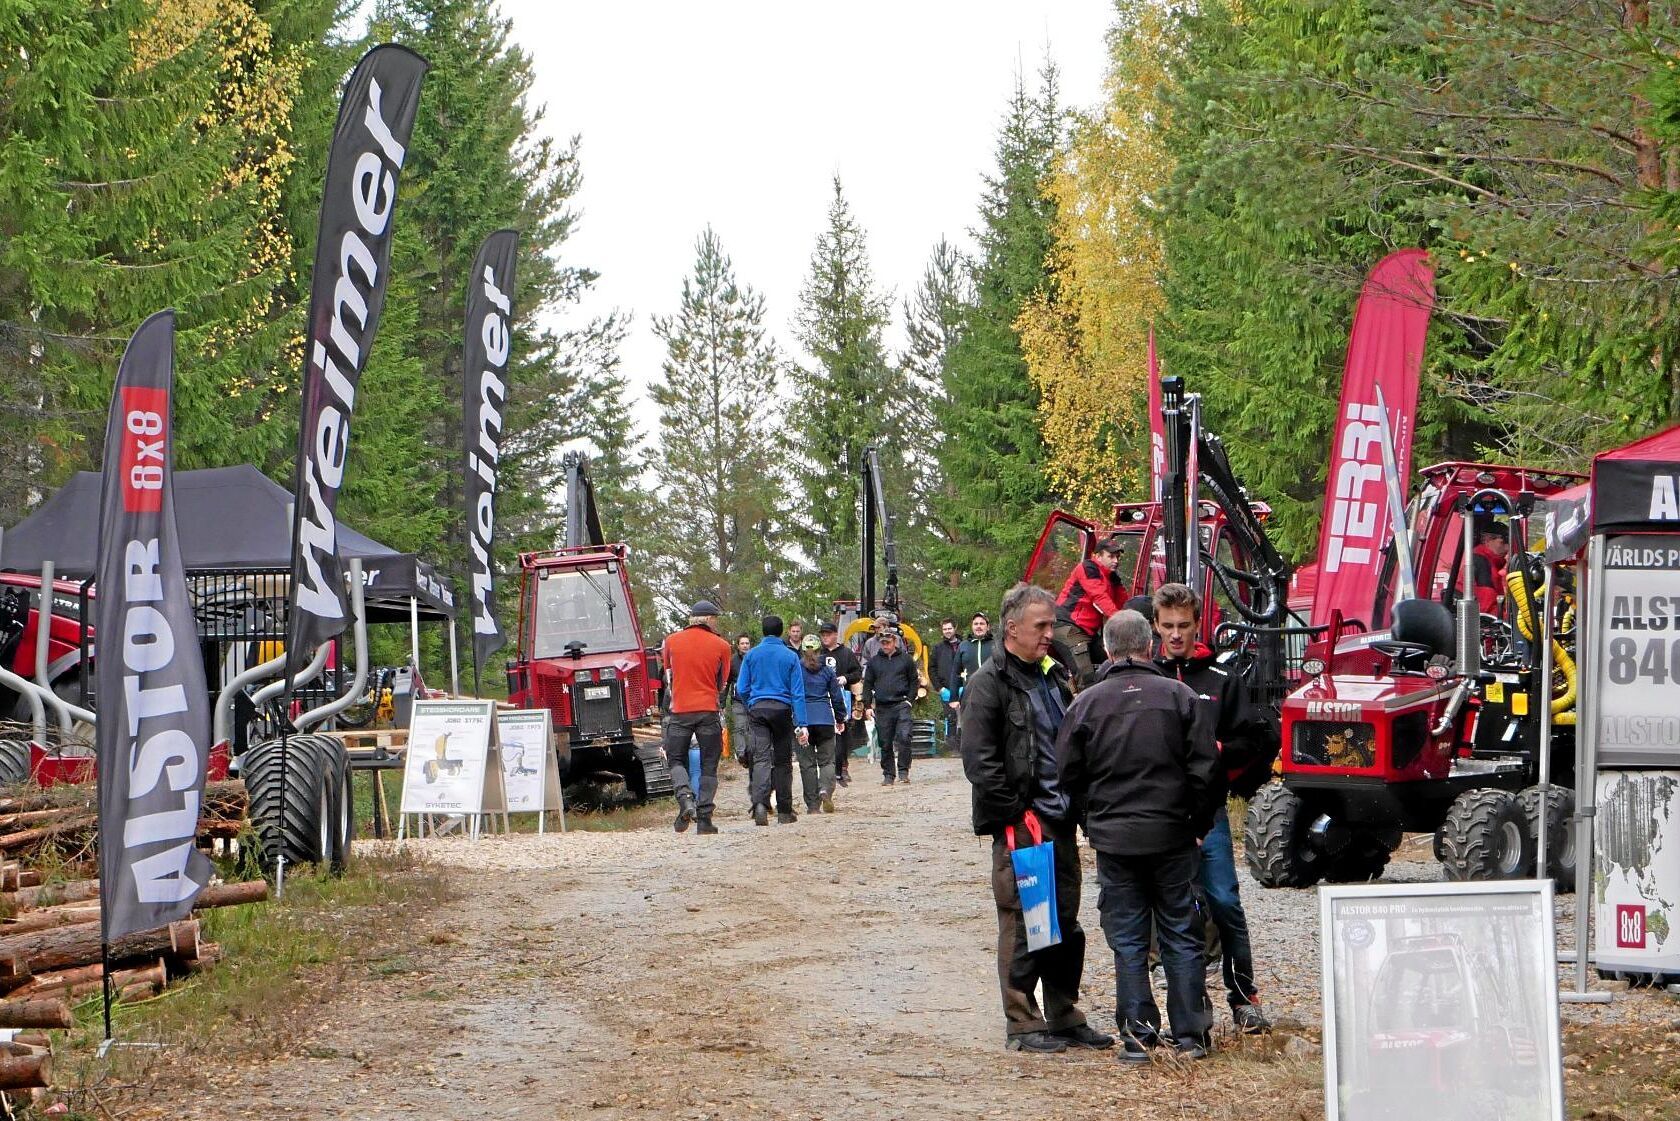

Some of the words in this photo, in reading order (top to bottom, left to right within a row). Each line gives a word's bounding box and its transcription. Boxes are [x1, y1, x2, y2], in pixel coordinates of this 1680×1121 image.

[296, 77, 405, 618] Weimer
[1649, 475, 1680, 520] A
[123, 538, 200, 903] ALSTOR
[1306, 701, 1362, 721] ALSTOR
[1341, 904, 1371, 915] ALSTOR
[1389, 903, 1406, 913] PRO
[1621, 910, 1641, 943] 8x8
